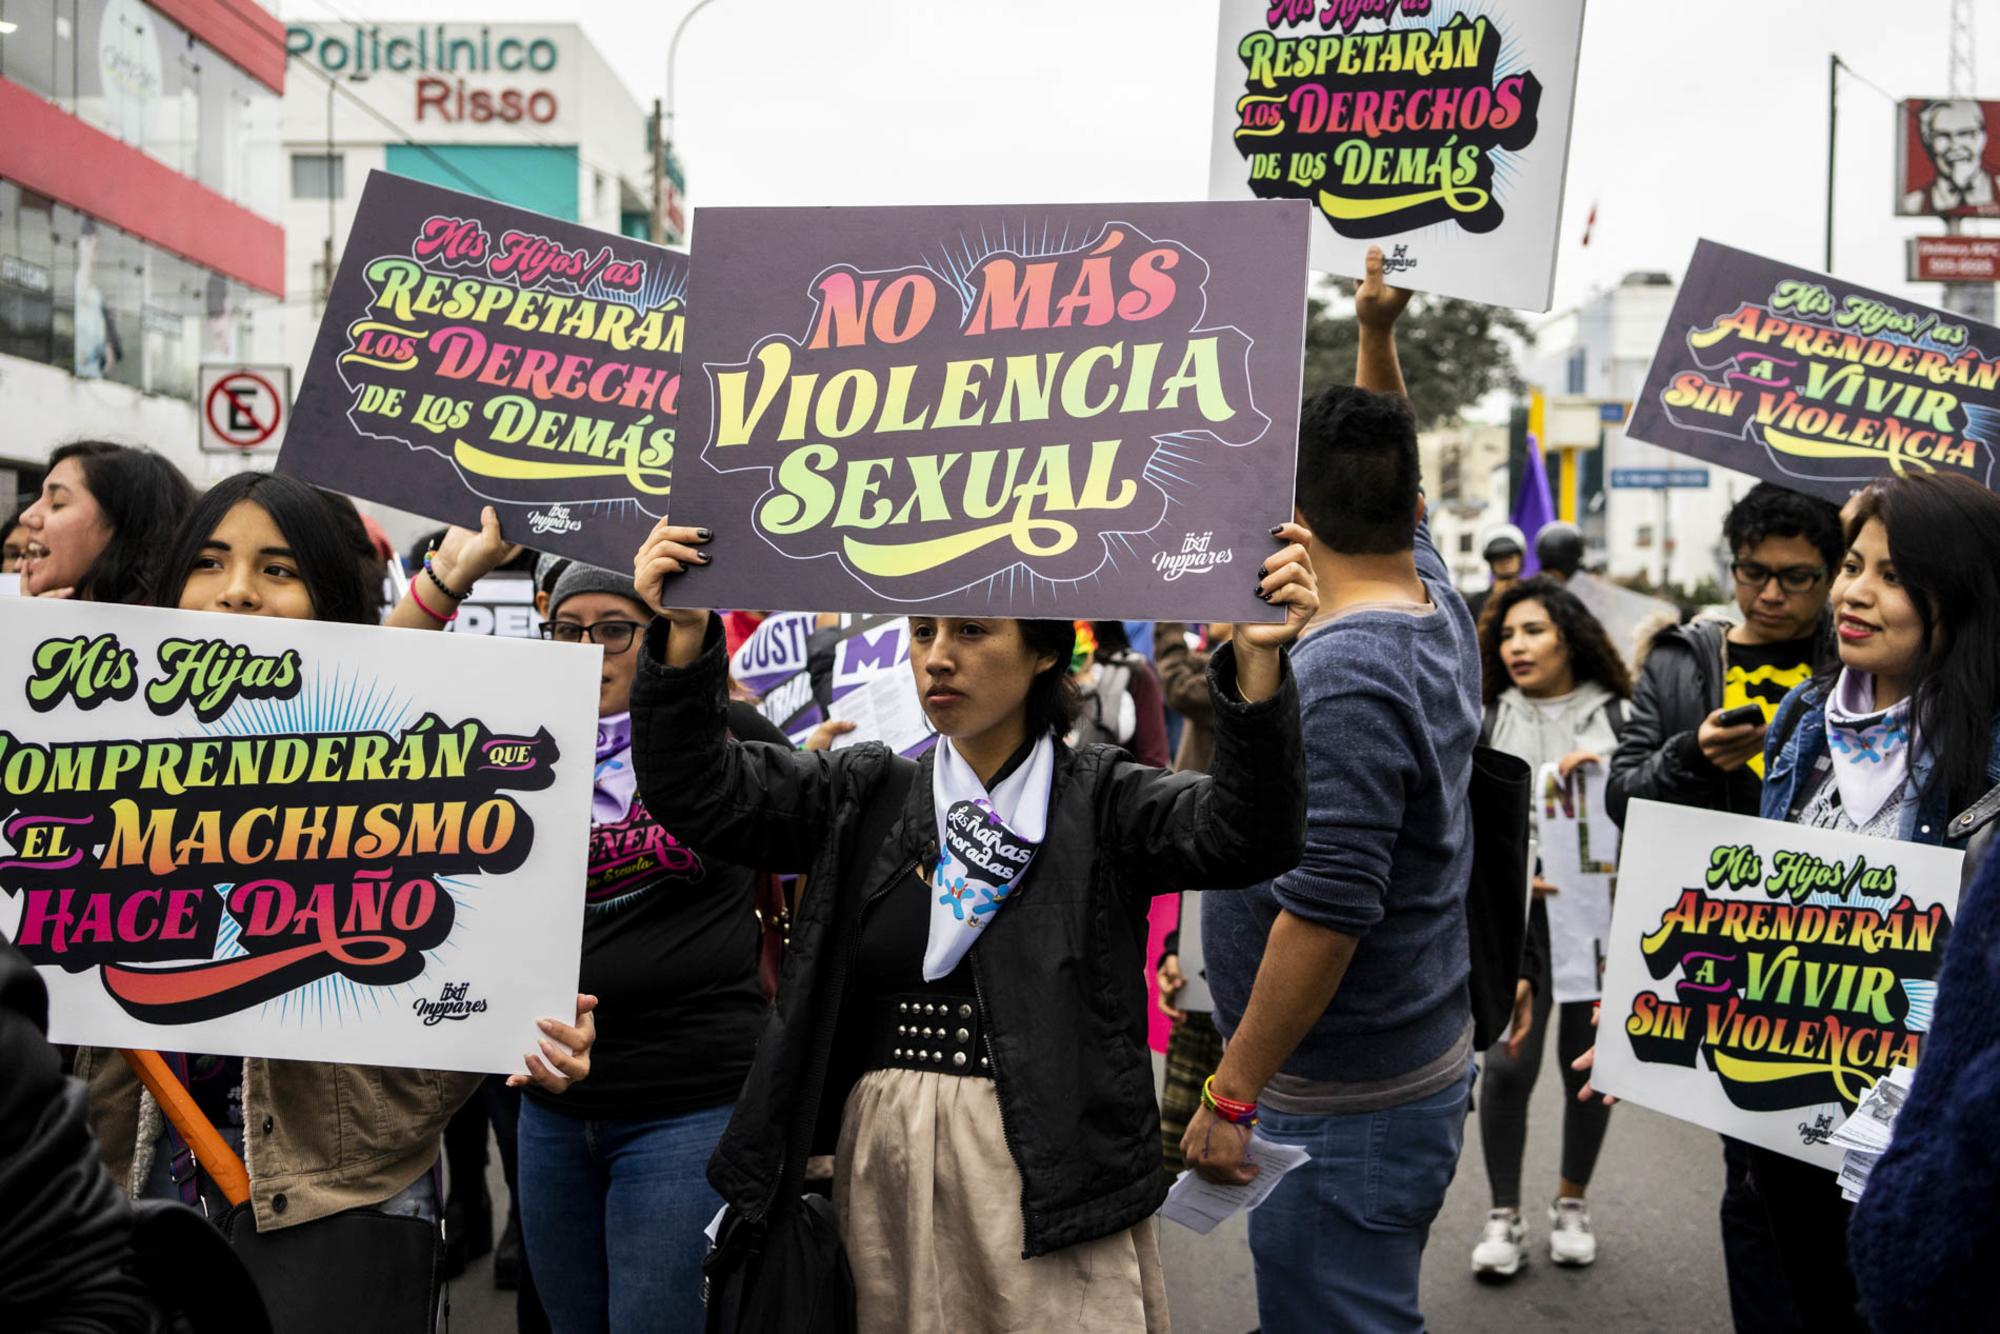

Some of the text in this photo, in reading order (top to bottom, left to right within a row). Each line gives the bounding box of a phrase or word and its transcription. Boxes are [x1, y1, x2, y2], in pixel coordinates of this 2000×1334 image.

[1267, 0, 1313, 23] Mis
[415, 77, 558, 125] Risso
[1243, 76, 1526, 139] LOS DERECHOS
[1253, 134, 1480, 196] DE LOS DEMÁS
[417, 217, 487, 259] Mis
[808, 230, 1180, 350] NO MÁS
[1772, 281, 1834, 316] Mis
[356, 331, 418, 361] LOS
[716, 336, 1237, 448] VIOLENCIA
[1664, 373, 1978, 470] SIN VIOLENCIA
[1750, 359, 1959, 433] A VIVIR
[358, 385, 676, 475] DE LOS DEMÁS
[760, 439, 1138, 556] SEXUAL
[30, 635, 301, 712] Mis Hijas
[0, 718, 533, 797] OMPRENDERÁN QUE
[20, 797, 517, 876] EL MACHISMO
[946, 827, 1014, 880] moradas
[1706, 845, 1761, 887] Mis
[18, 867, 438, 954] HACE DAÑO
[1641, 889, 1942, 955] APRENDERÁN
[1694, 944, 1895, 1025] A VIVIR
[1625, 991, 1920, 1070] SIN VIOLENCIA
